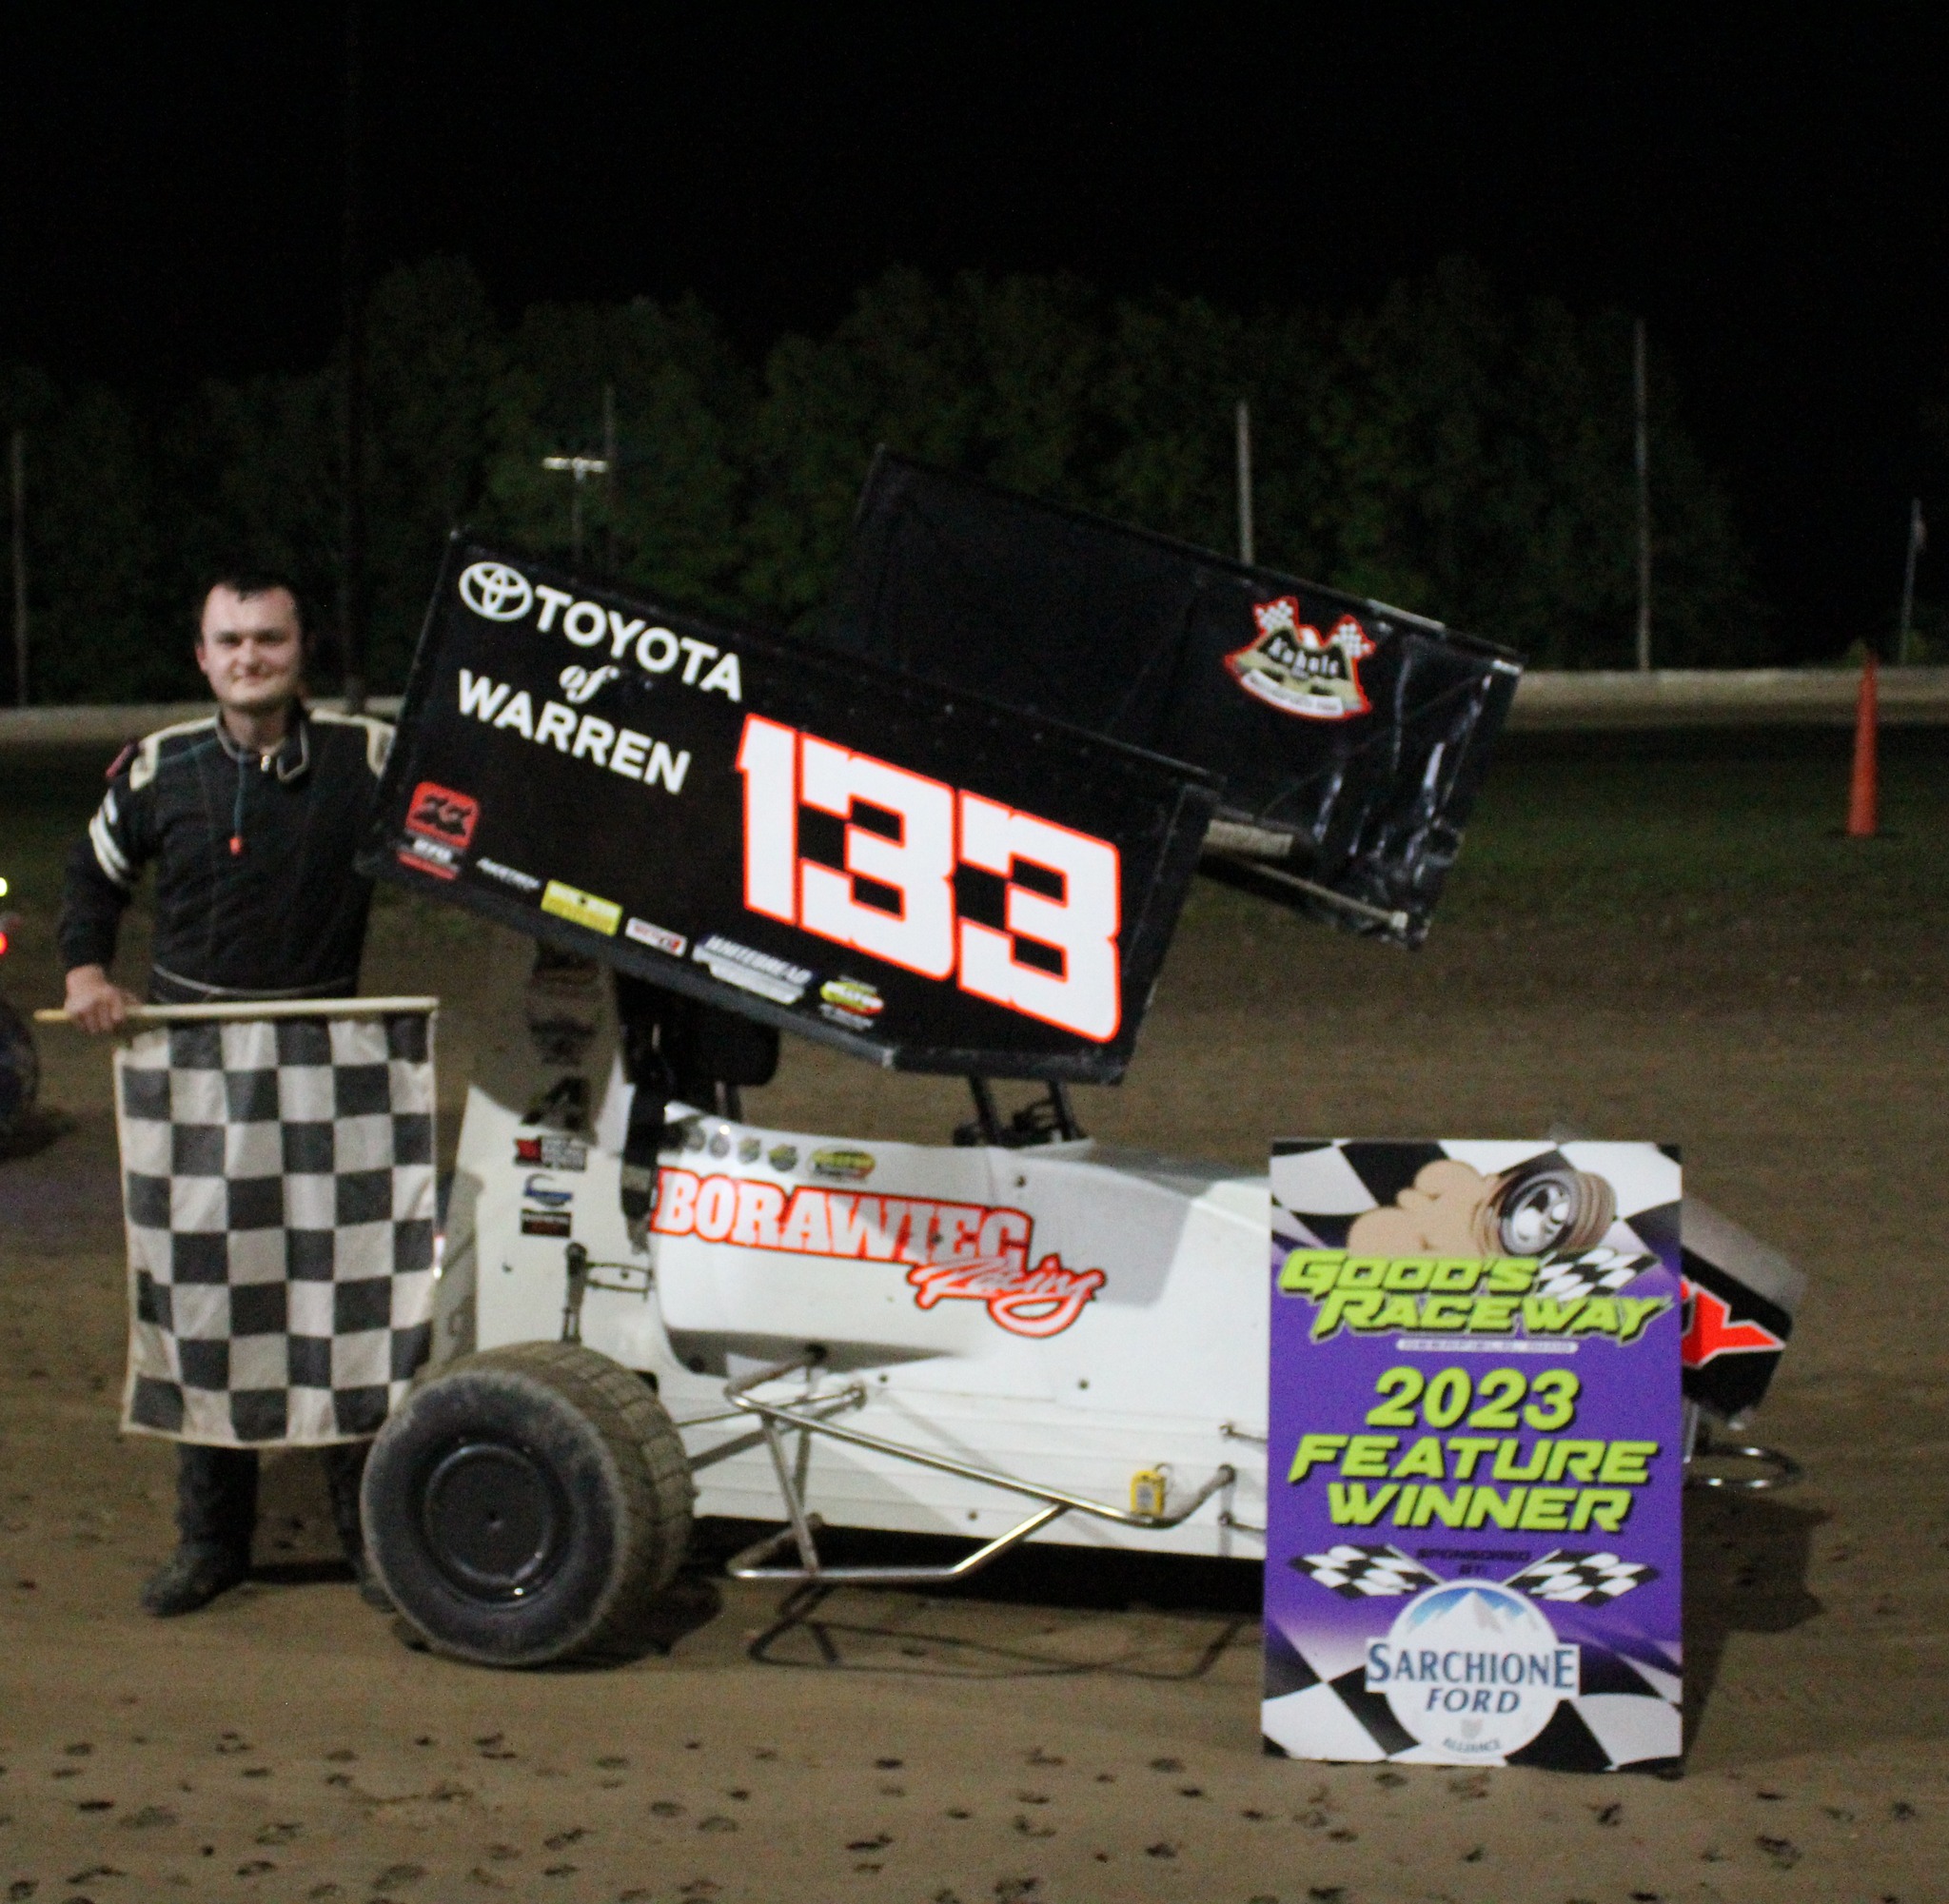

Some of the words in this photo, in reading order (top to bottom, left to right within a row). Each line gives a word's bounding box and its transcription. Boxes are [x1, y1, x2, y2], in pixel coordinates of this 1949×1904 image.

[535, 584, 741, 702] TOYOTA
[559, 664, 620, 704] of
[458, 668, 692, 795] WARREN
[735, 712, 1122, 1043] 133
[1278, 1247, 1540, 1301] GOOD'S
[1309, 1288, 1674, 1345] RACEWAY
[1365, 1366, 1582, 1431] 2023
[1287, 1433, 1660, 1484] FEATURE
[1327, 1482, 1633, 1534] WINNER
[1366, 1642, 1576, 1689] SARCHIONE
[1426, 1687, 1521, 1714] FORD
